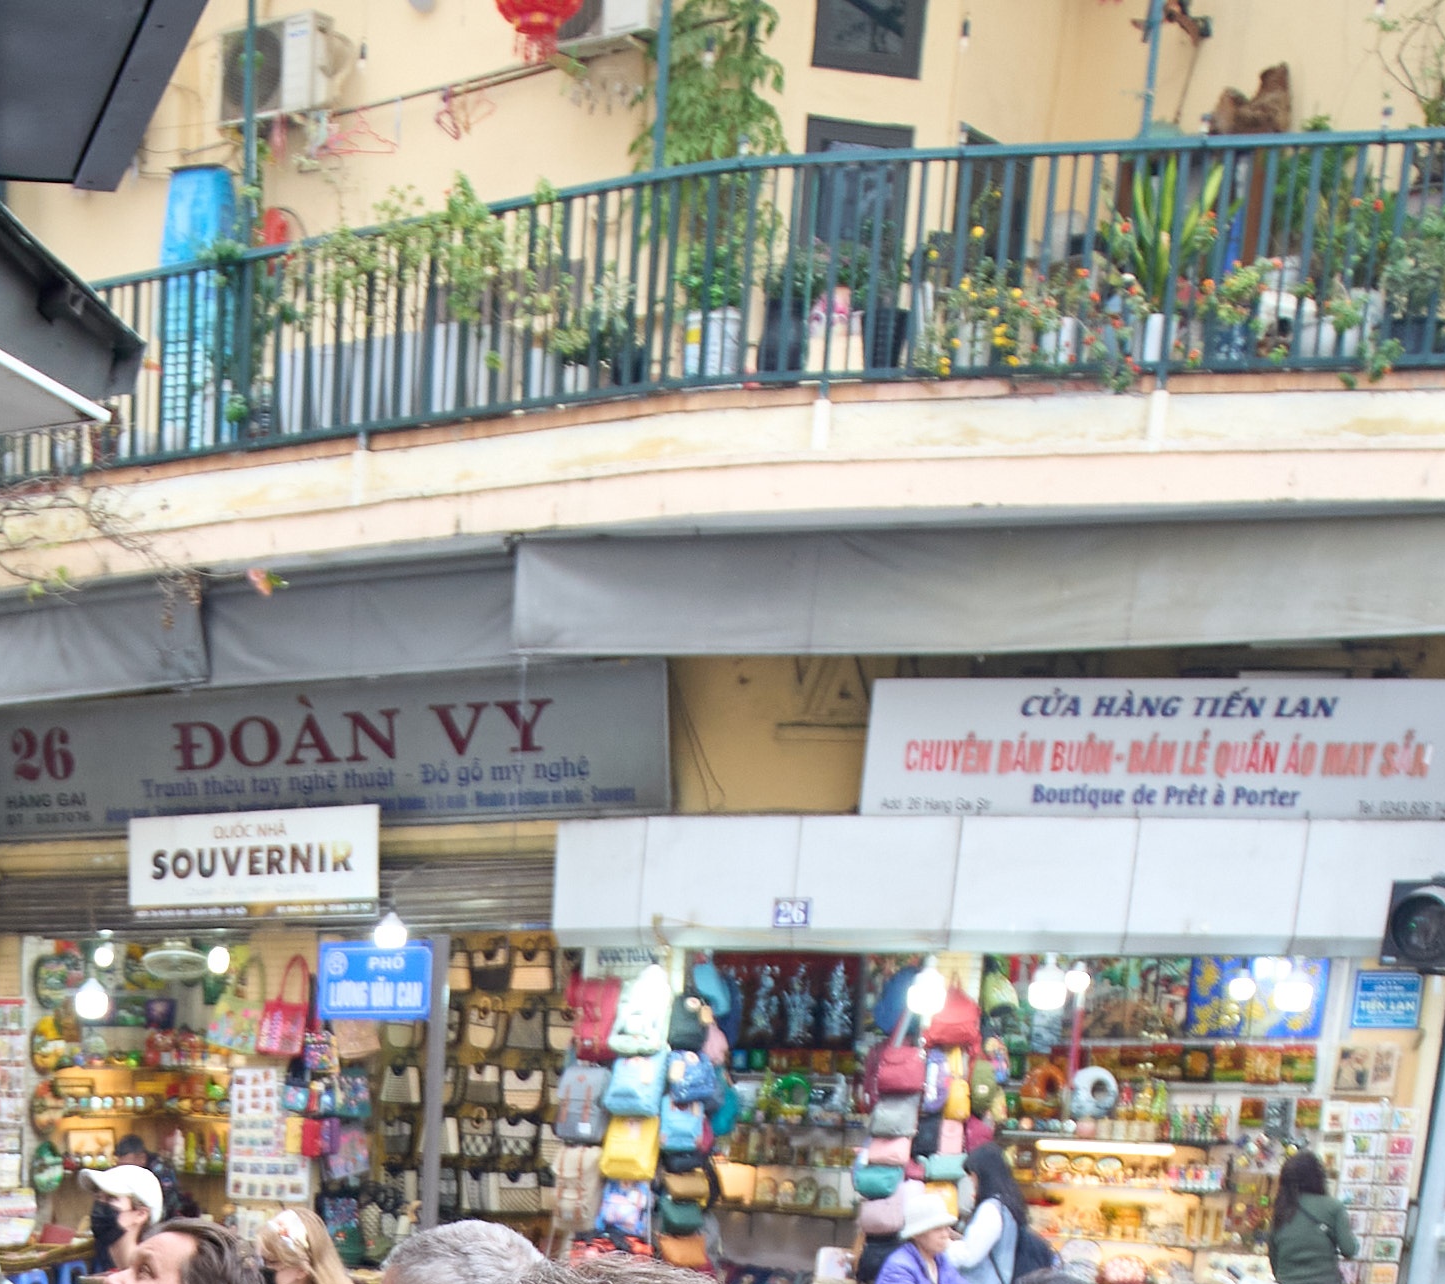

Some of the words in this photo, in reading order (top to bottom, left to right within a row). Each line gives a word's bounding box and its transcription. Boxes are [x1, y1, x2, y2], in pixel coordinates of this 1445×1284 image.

[1091, 689, 1183, 718] HÀNG
[1273, 697, 1339, 718] LAN
[172, 694, 400, 771] ĐOÀN
[429, 698, 553, 755] VY
[13, 727, 75, 781] 26
[904, 731, 992, 775] CHUYÊN
[997, 731, 1045, 775] BÁN
[1127, 732, 1177, 776] BÁN
[1282, 733, 1318, 777] ÁO
[1321, 742, 1376, 777] MAY
[1031, 784, 1125, 809] Boutique
[1131, 785, 1158, 806] de
[1164, 785, 1207, 806] Prêt
[1233, 785, 1301, 807] Porter
[151, 839, 354, 881] SOUVERNIR
[777, 900, 806, 924] 26
[367, 951, 407, 971] PHỐ
